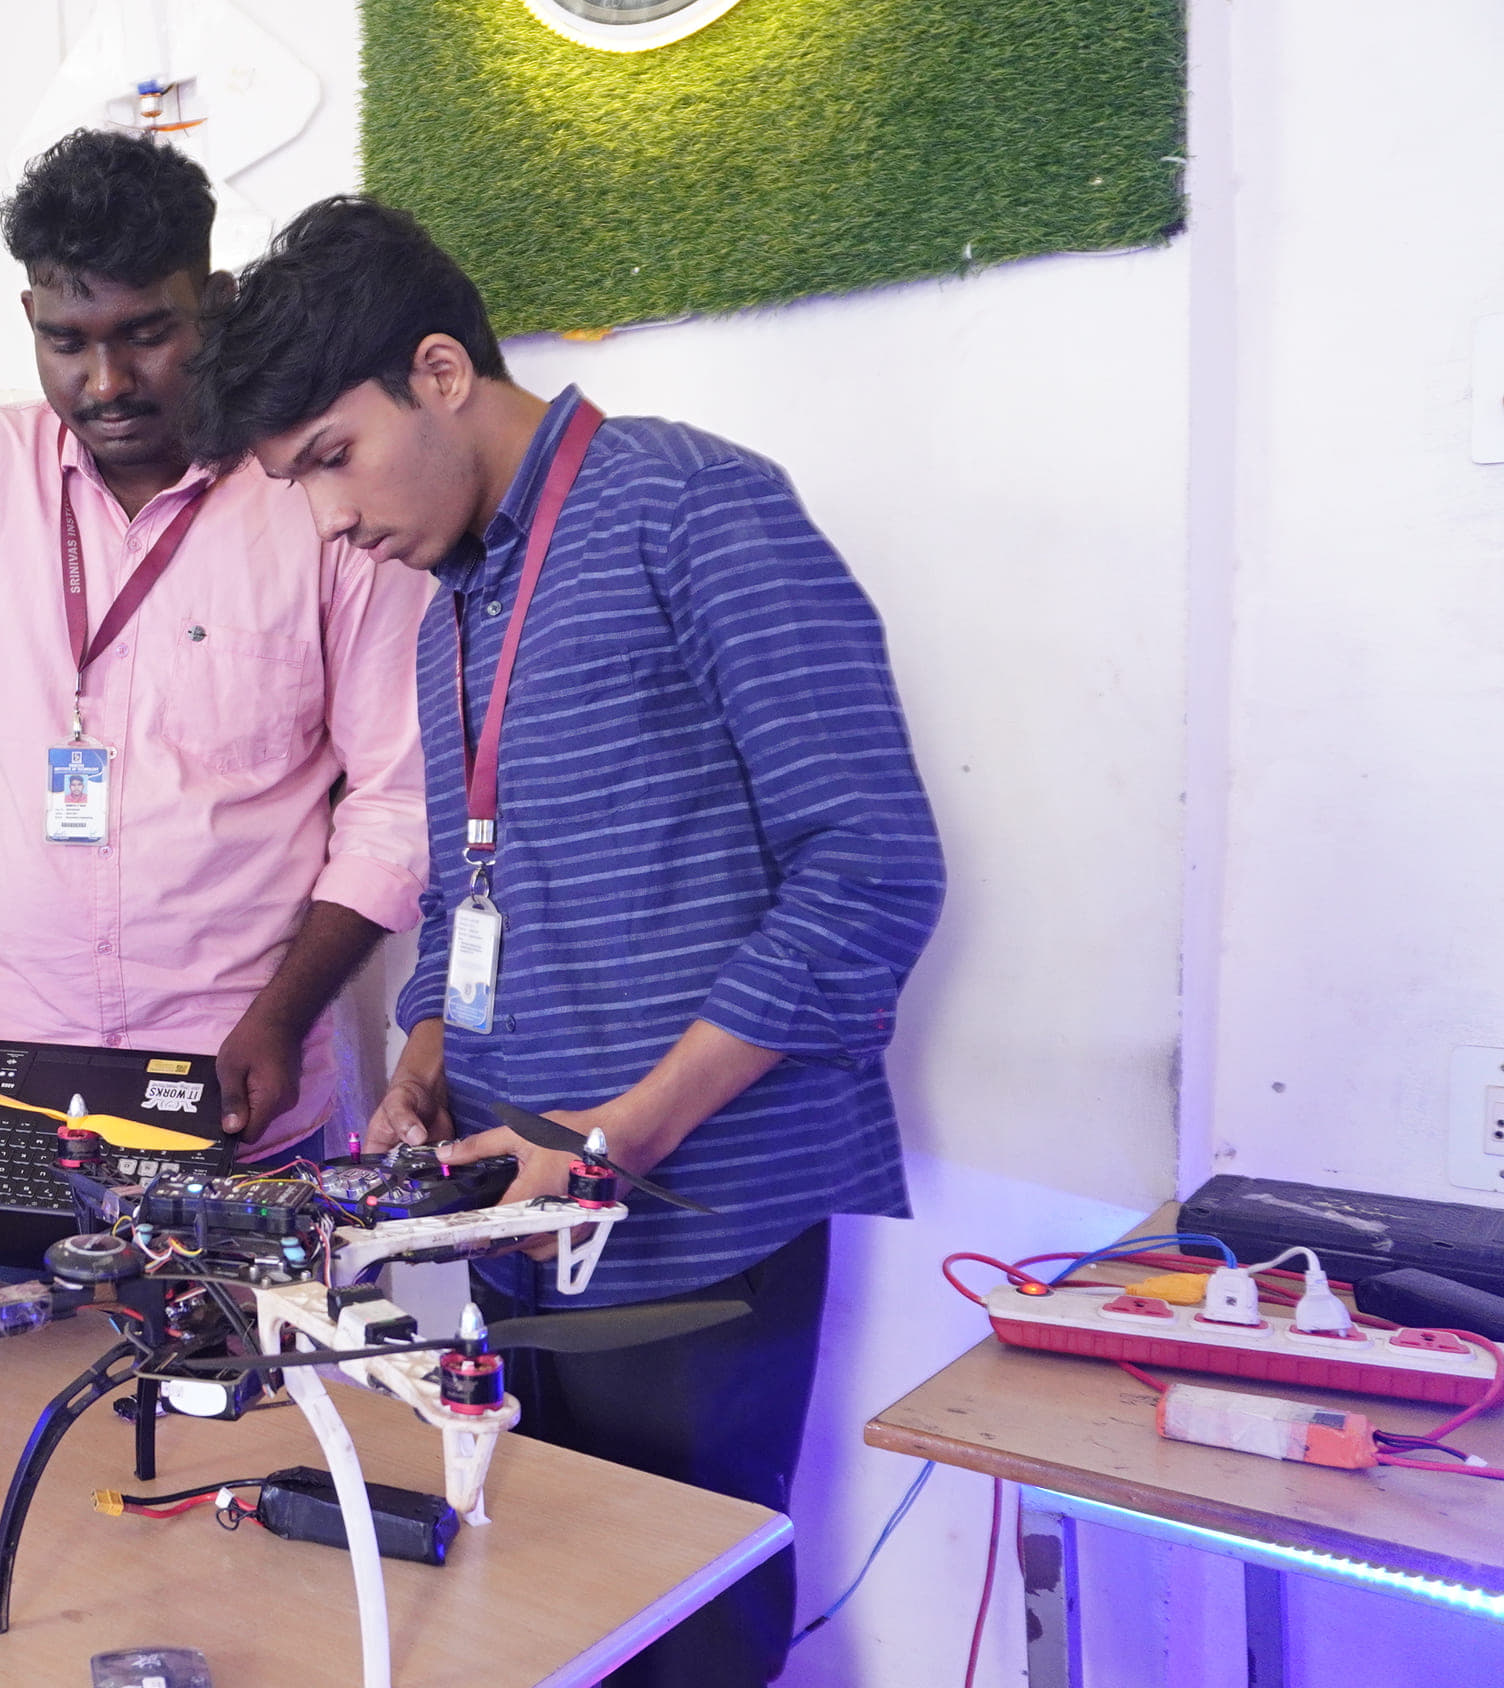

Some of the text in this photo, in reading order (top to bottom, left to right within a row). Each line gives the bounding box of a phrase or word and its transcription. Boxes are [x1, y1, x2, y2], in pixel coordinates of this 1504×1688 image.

[67, 539, 81, 594] SRINIVAS
[149, 1087, 186, 1099] WORKS
[187, 1090, 199, 1100] IT
